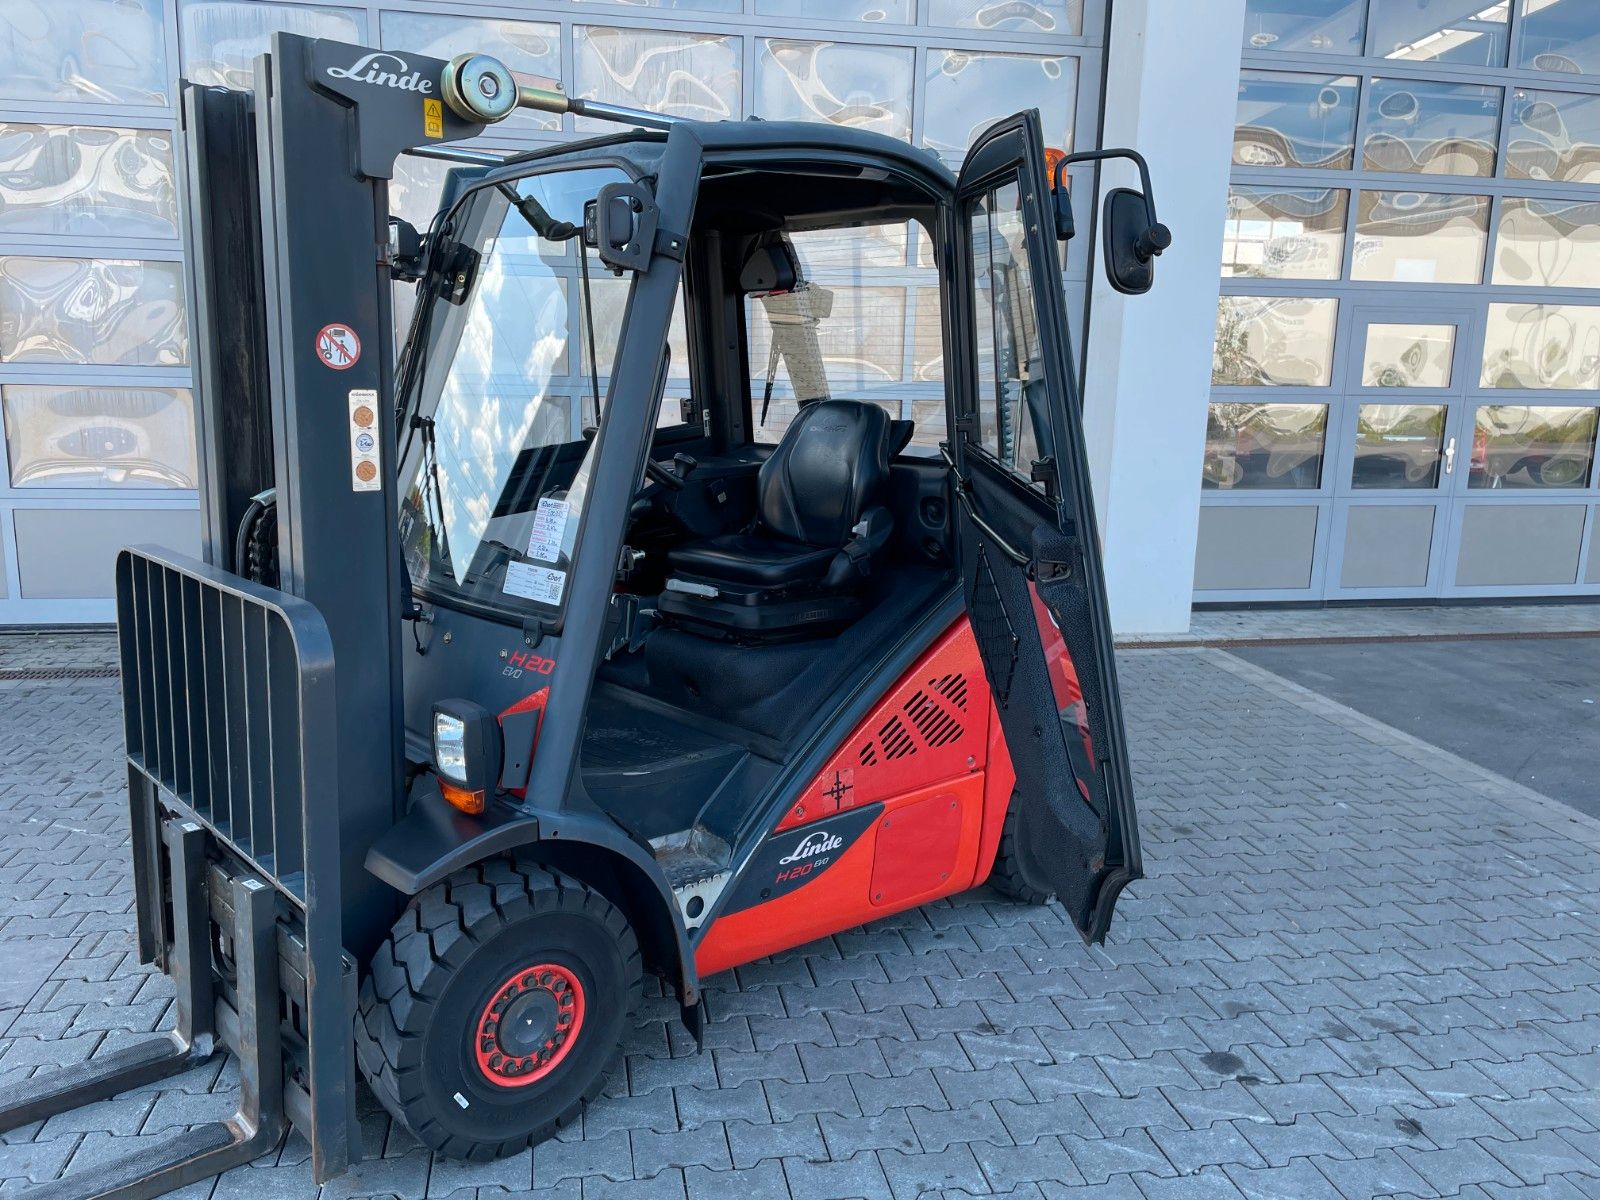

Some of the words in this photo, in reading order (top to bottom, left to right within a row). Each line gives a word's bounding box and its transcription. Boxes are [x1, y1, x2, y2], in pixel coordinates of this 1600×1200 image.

[326, 53, 433, 94] Linde
[502, 665, 522, 678] EVO
[509, 650, 555, 674] H20
[779, 831, 843, 865] Linde
[776, 863, 813, 883] H20
